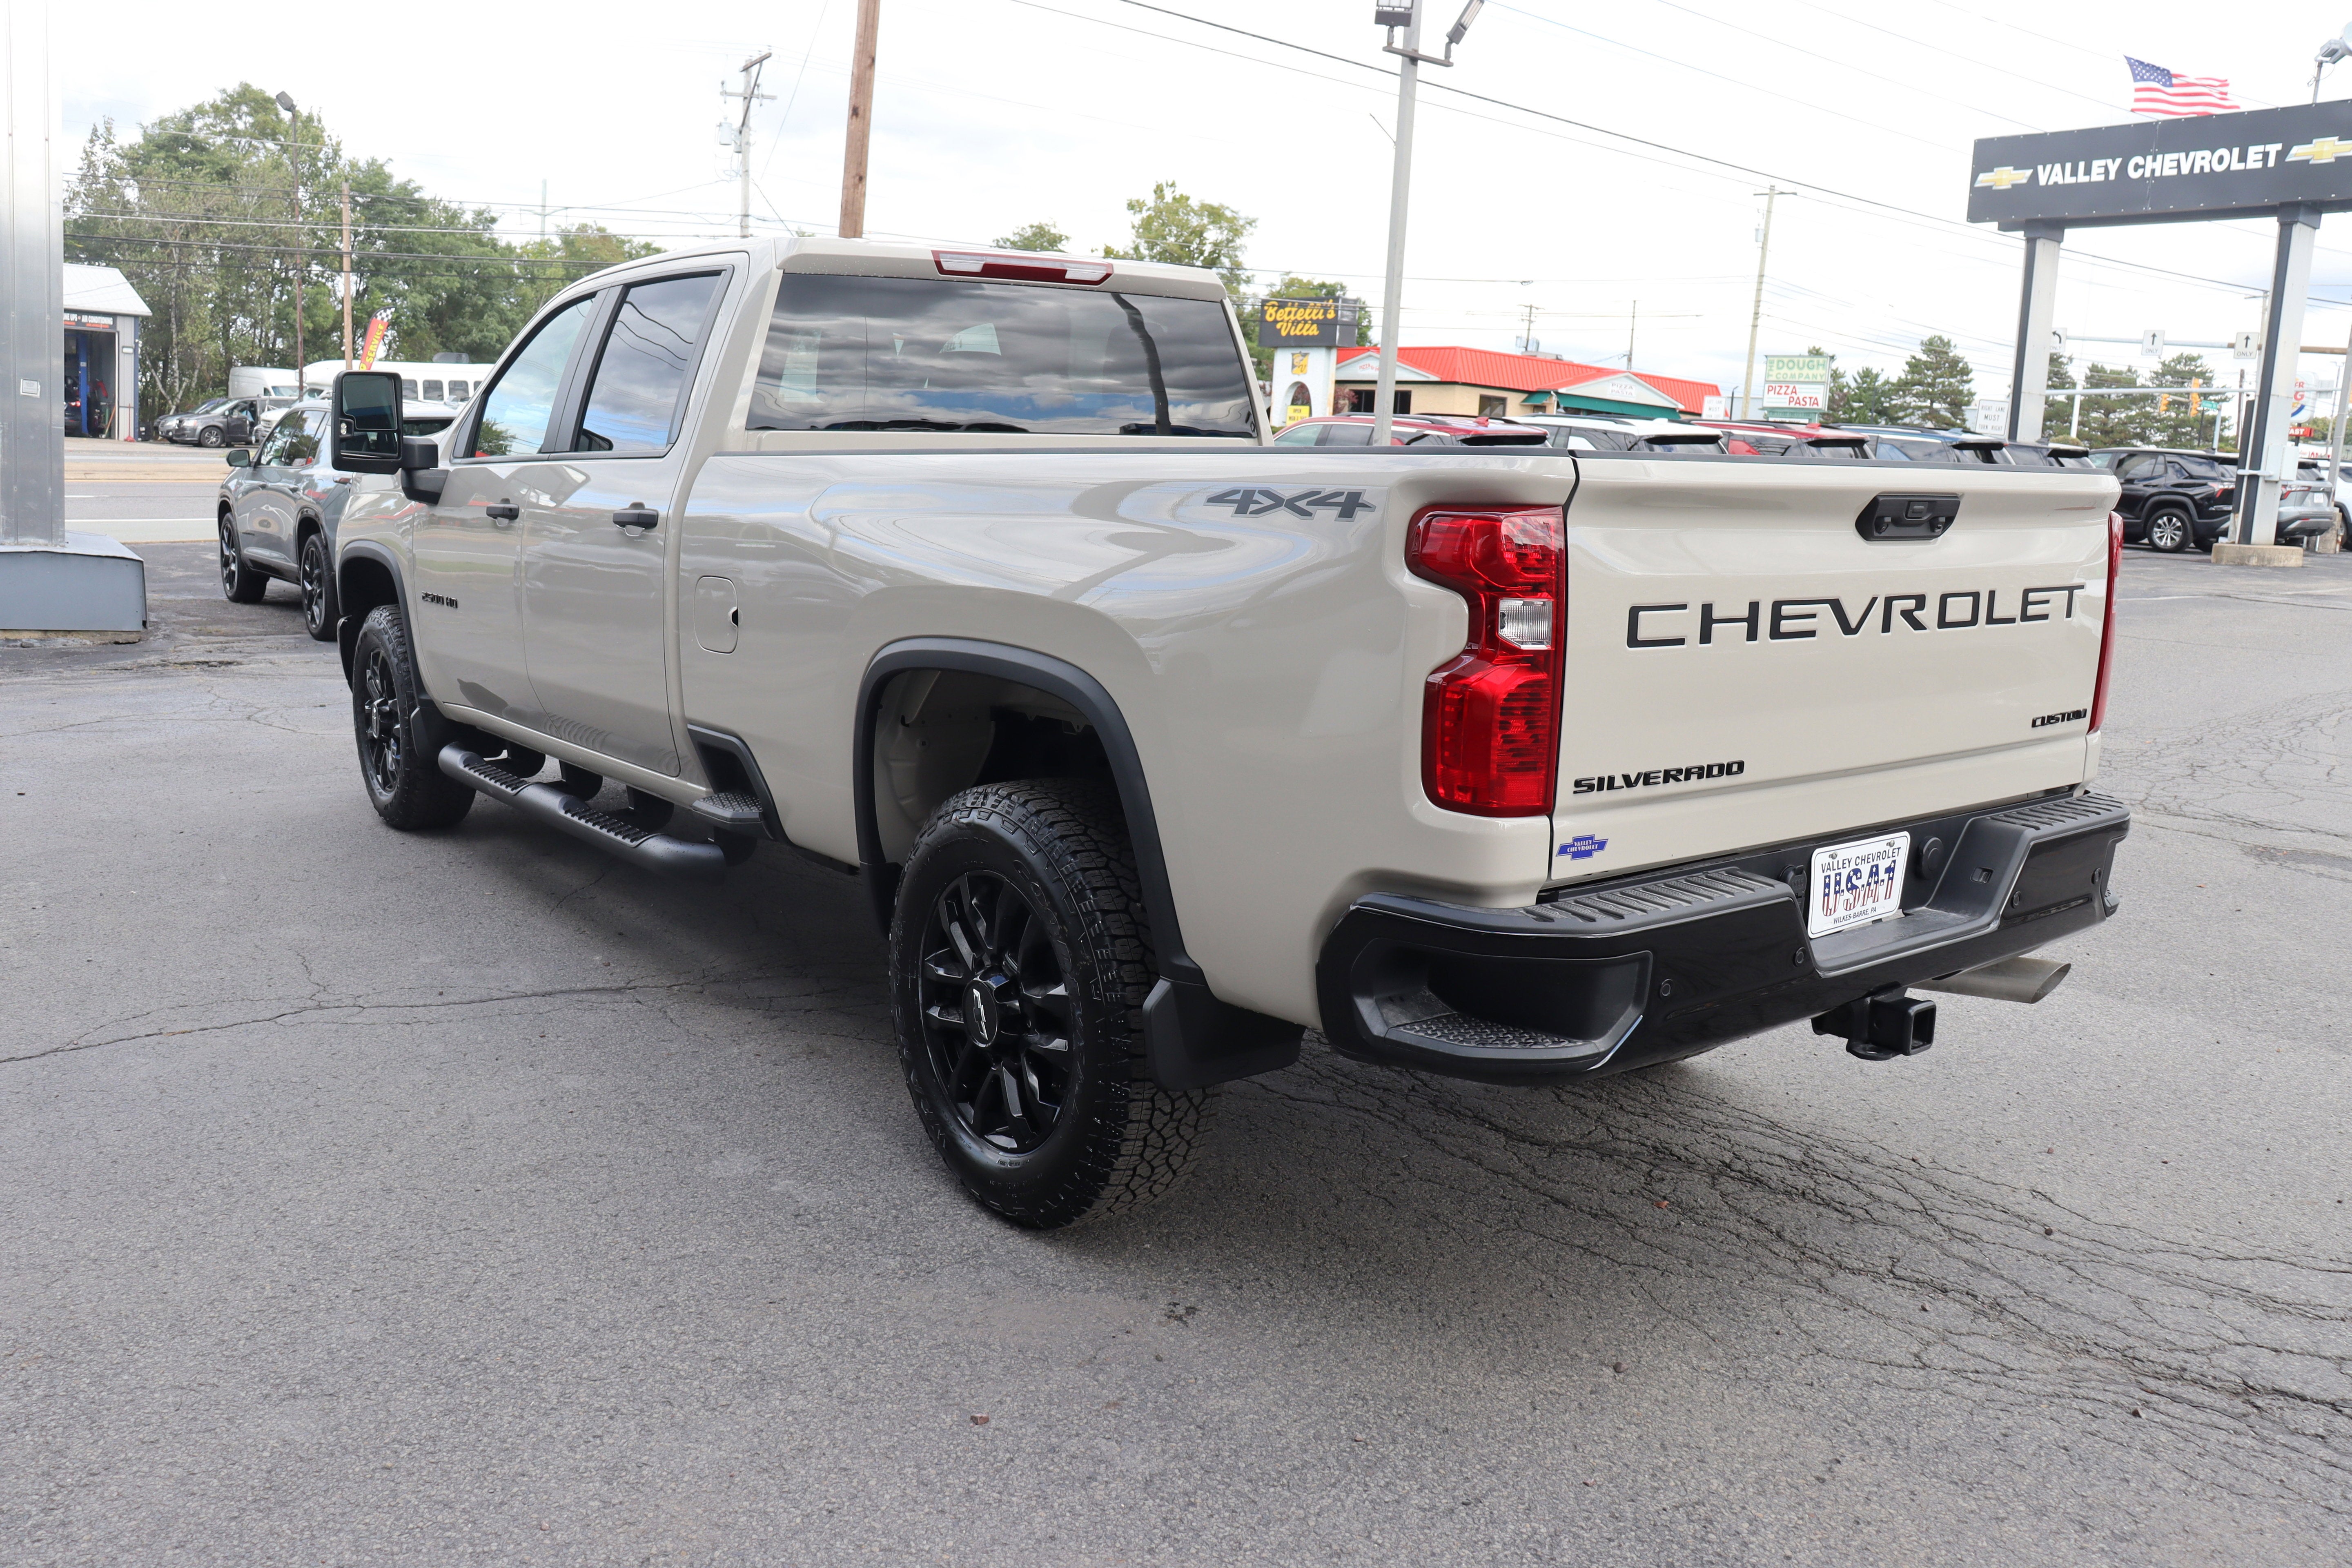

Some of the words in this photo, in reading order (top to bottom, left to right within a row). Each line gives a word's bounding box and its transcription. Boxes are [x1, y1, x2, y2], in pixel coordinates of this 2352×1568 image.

[2037, 158, 2123, 186] VALLEY
[2127, 143, 2282, 179] CHEVROLET
[1264, 299, 1336, 322] Bettelli's
[1276, 320, 1319, 336] Villa
[365, 323, 385, 363] SERVICE
[1777, 359, 1826, 370] DOUGH
[1768, 385, 1797, 395] PIZZA
[1788, 396, 1819, 406] PASTA
[422, 591, 444, 605] 2500
[446, 596, 458, 609] HD
[1626, 584, 2085, 648] CHEVROLET
[2031, 708, 2087, 728] CUSTOM
[1573, 760, 1745, 794] SILVERADO
[1567, 844, 1598, 853] CHEVROLET
[1821, 857, 1852, 873] VALLEY
[1855, 847, 1901, 866] CHEVROLET
[1833, 909, 1869, 924] WILKES-BARRE,
